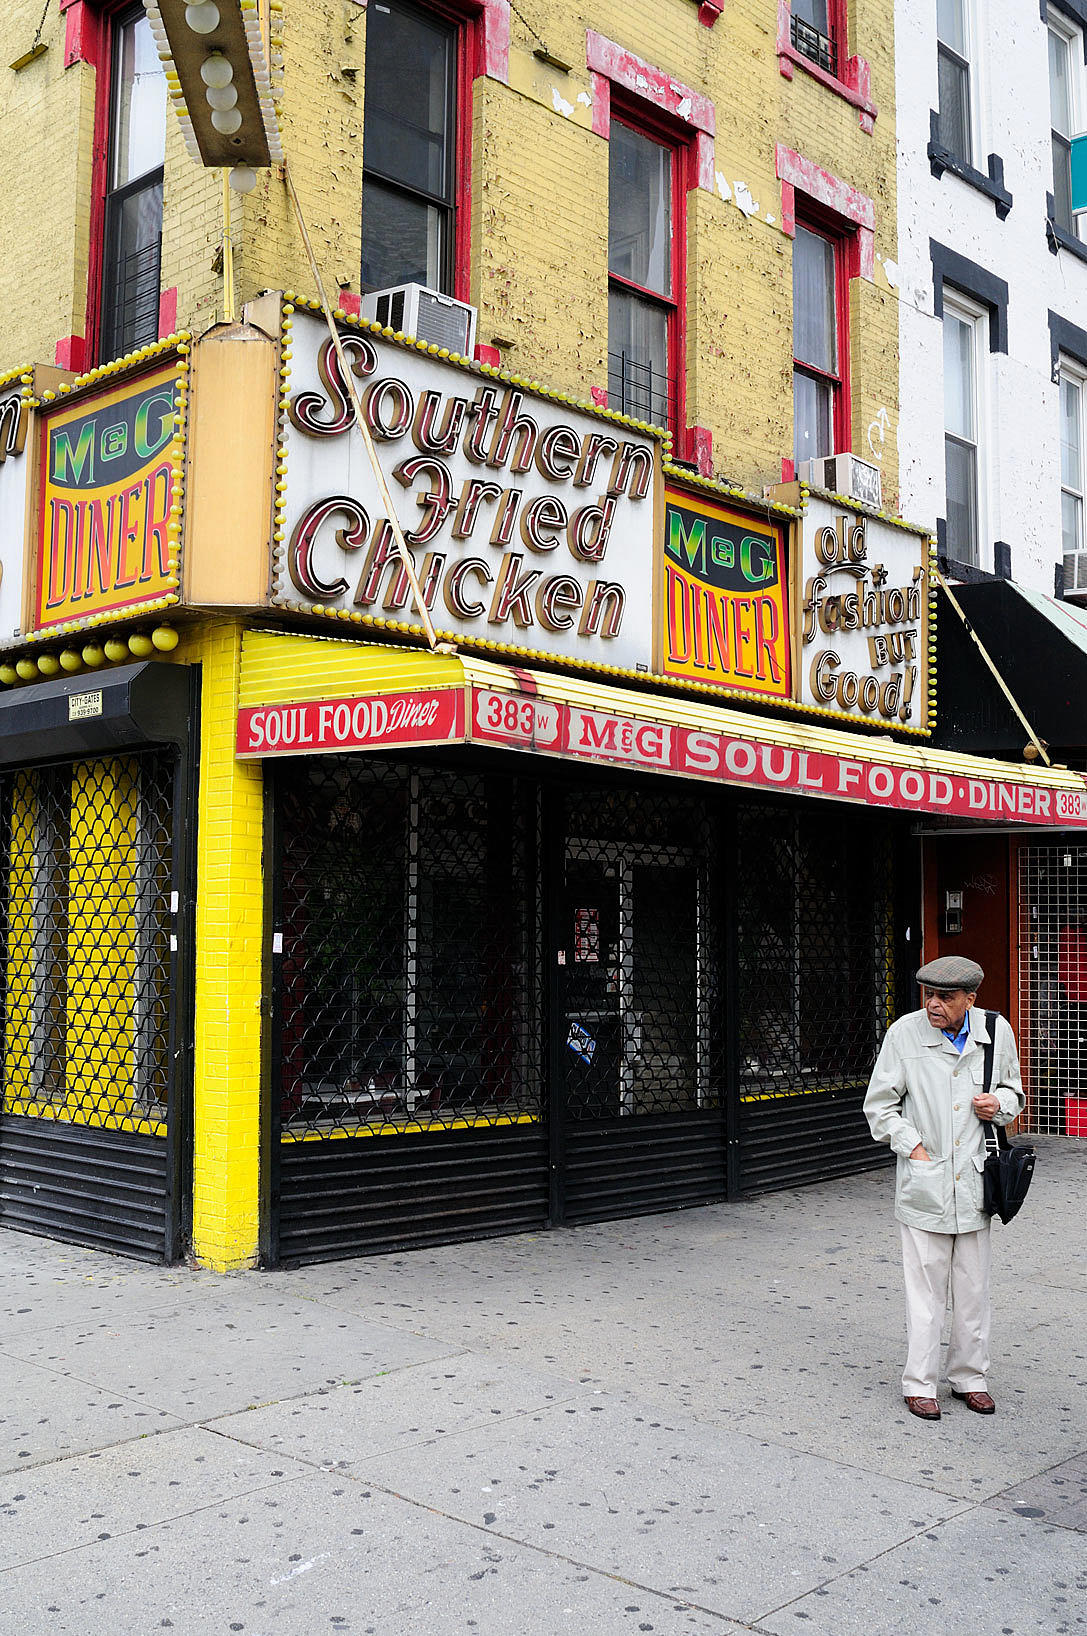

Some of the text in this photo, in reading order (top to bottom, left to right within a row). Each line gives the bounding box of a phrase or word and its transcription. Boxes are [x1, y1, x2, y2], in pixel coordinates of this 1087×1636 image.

[288, 331, 653, 499] Southern
[46, 461, 176, 609] DINER
[392, 455, 618, 562] Fried
[815, 516, 867, 564] old
[288, 495, 627, 637] Chicken
[666, 564, 782, 684] DINER
[868, 629, 917, 669] BUT
[249, 698, 440, 747] SOUL FOOD Diner
[487, 696, 535, 734] 383
[809, 650, 917, 723] Good!
[685, 732, 823, 788] SOUL
[837, 760, 953, 805] FOOD
[968, 780, 1051, 817] DINER
[1060, 793, 1080, 816] 383
